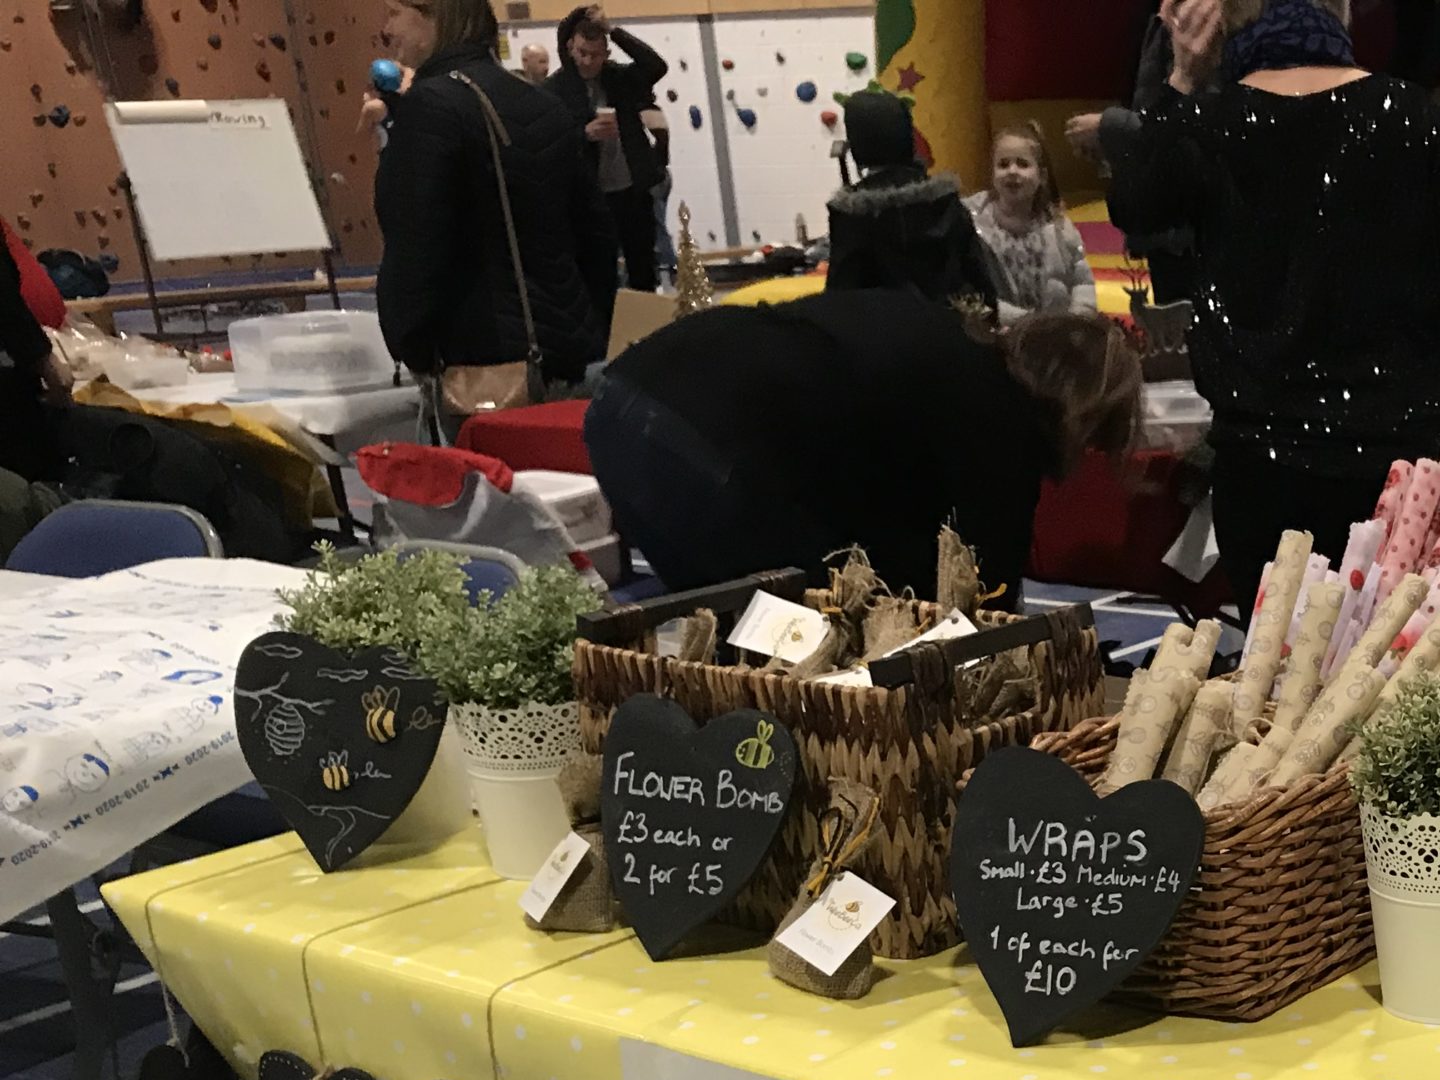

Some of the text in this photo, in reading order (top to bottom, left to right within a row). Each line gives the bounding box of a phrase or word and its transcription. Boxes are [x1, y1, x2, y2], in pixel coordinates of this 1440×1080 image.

[618, 811, 733, 851] £3 each or
[1007, 817, 1149, 864] WRAPS
[623, 852, 724, 895] 2 for £5
[990, 925, 1001, 951] 1
[1008, 932, 1031, 963] of
[1038, 938, 1096, 959] each
[1024, 960, 1077, 996] £10
